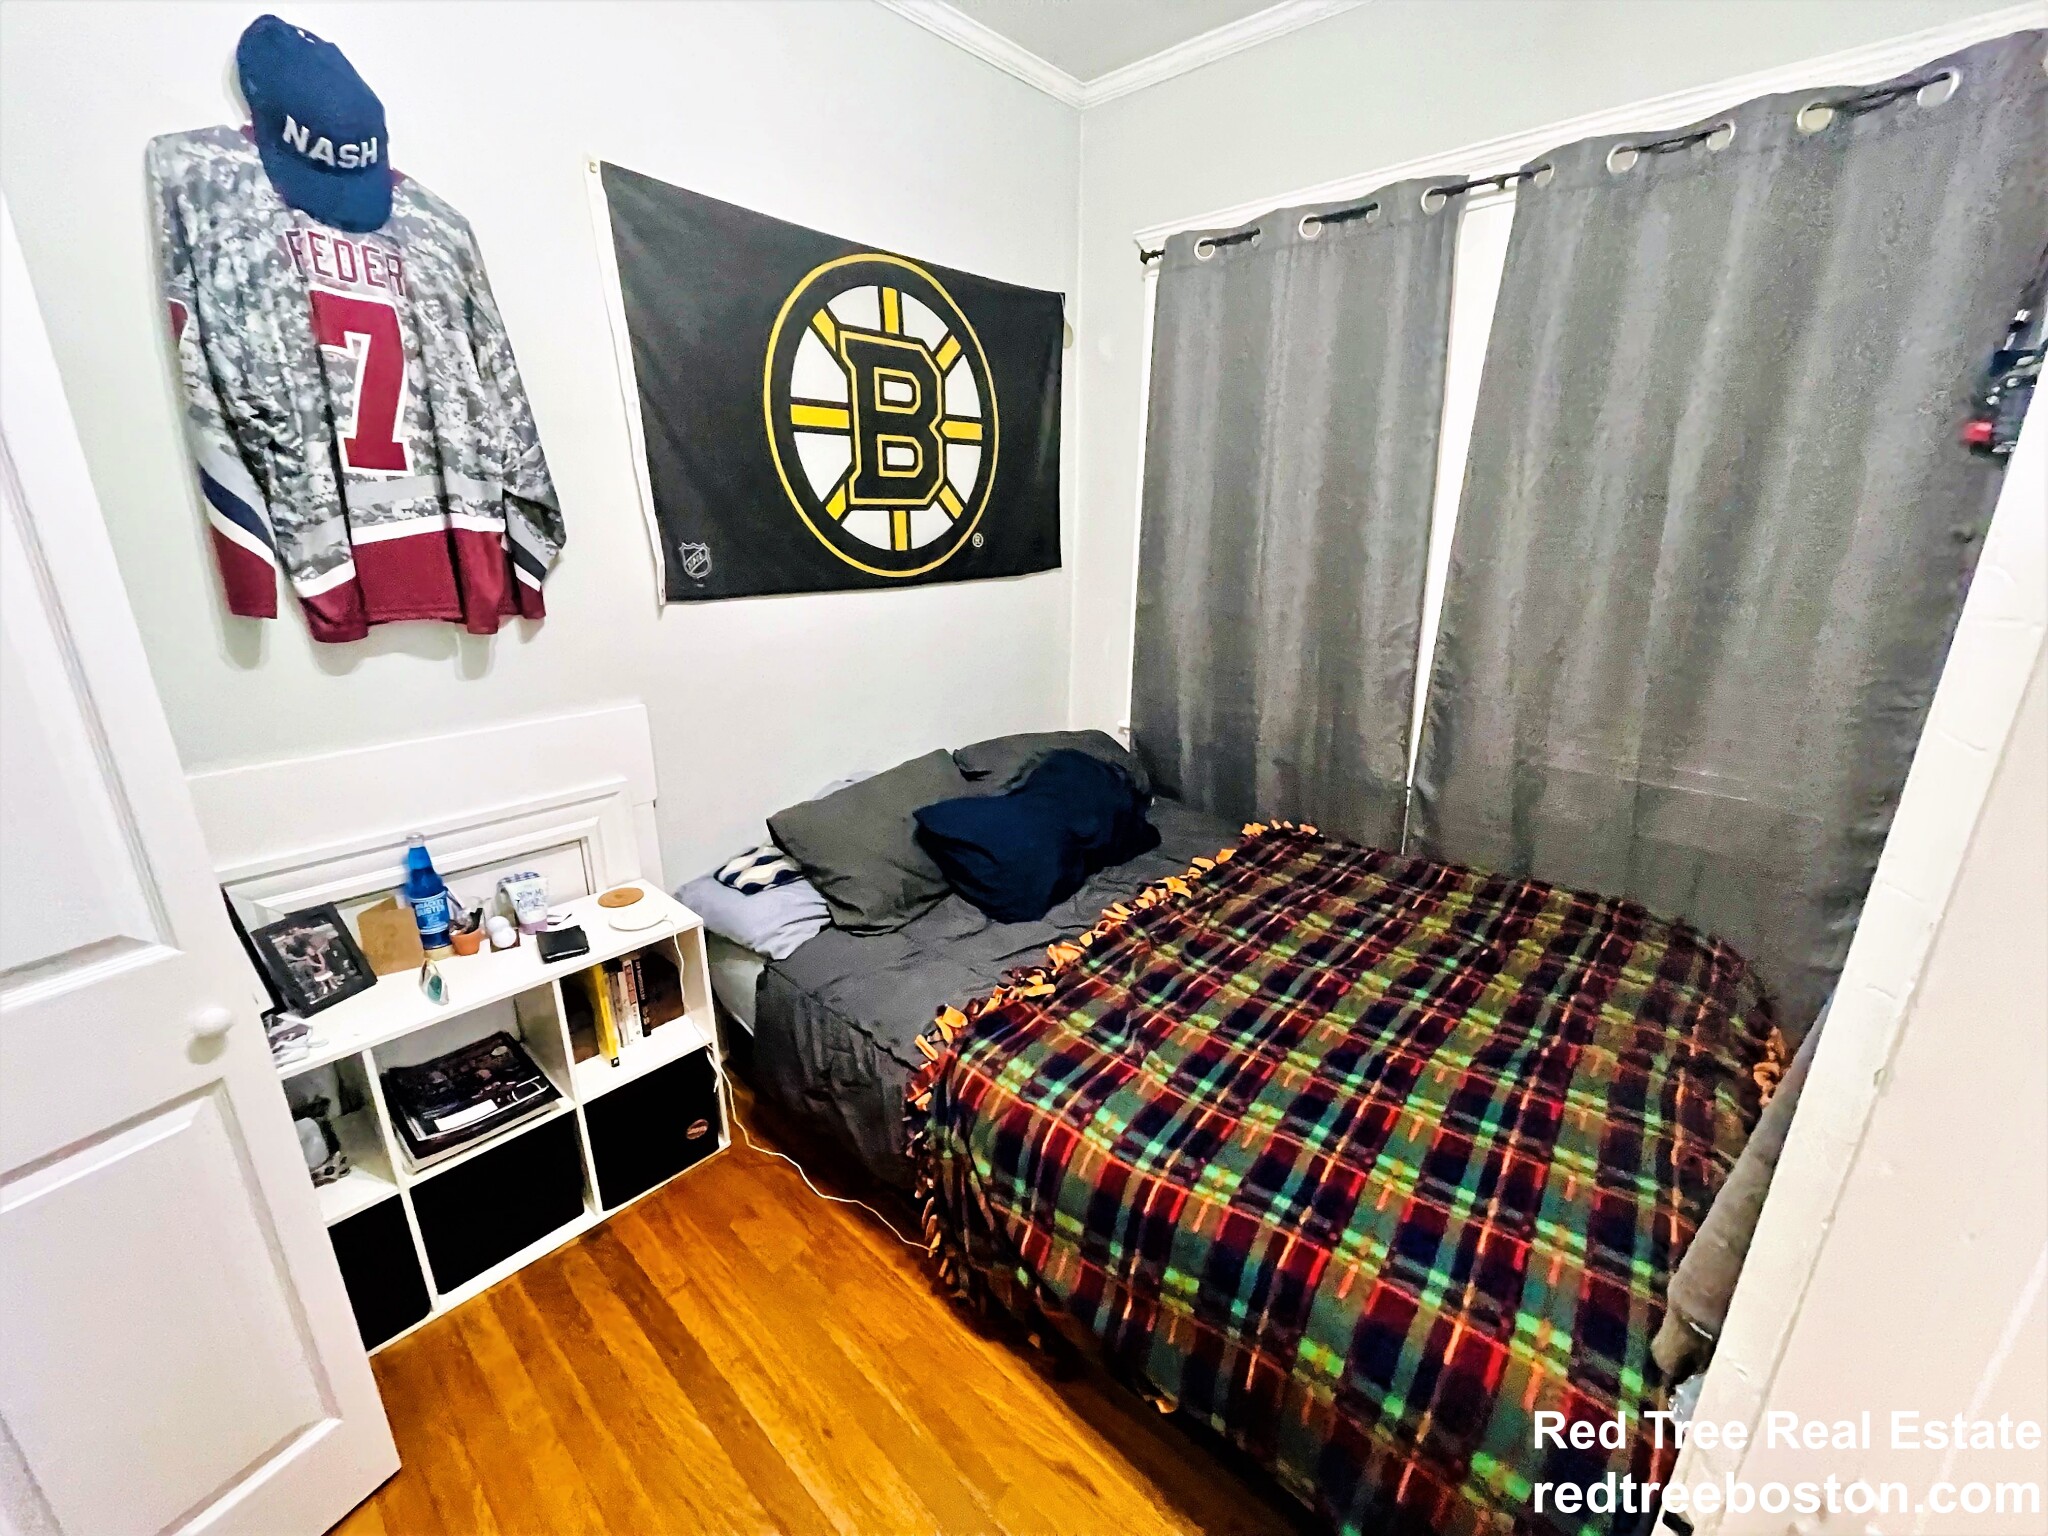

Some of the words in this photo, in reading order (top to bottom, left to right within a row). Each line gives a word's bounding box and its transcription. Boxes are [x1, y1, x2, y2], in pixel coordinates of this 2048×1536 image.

[282, 114, 378, 169] NASH
[284, 229, 406, 298] FEDER
[308, 284, 414, 476] 7
[838, 330, 947, 506] B
